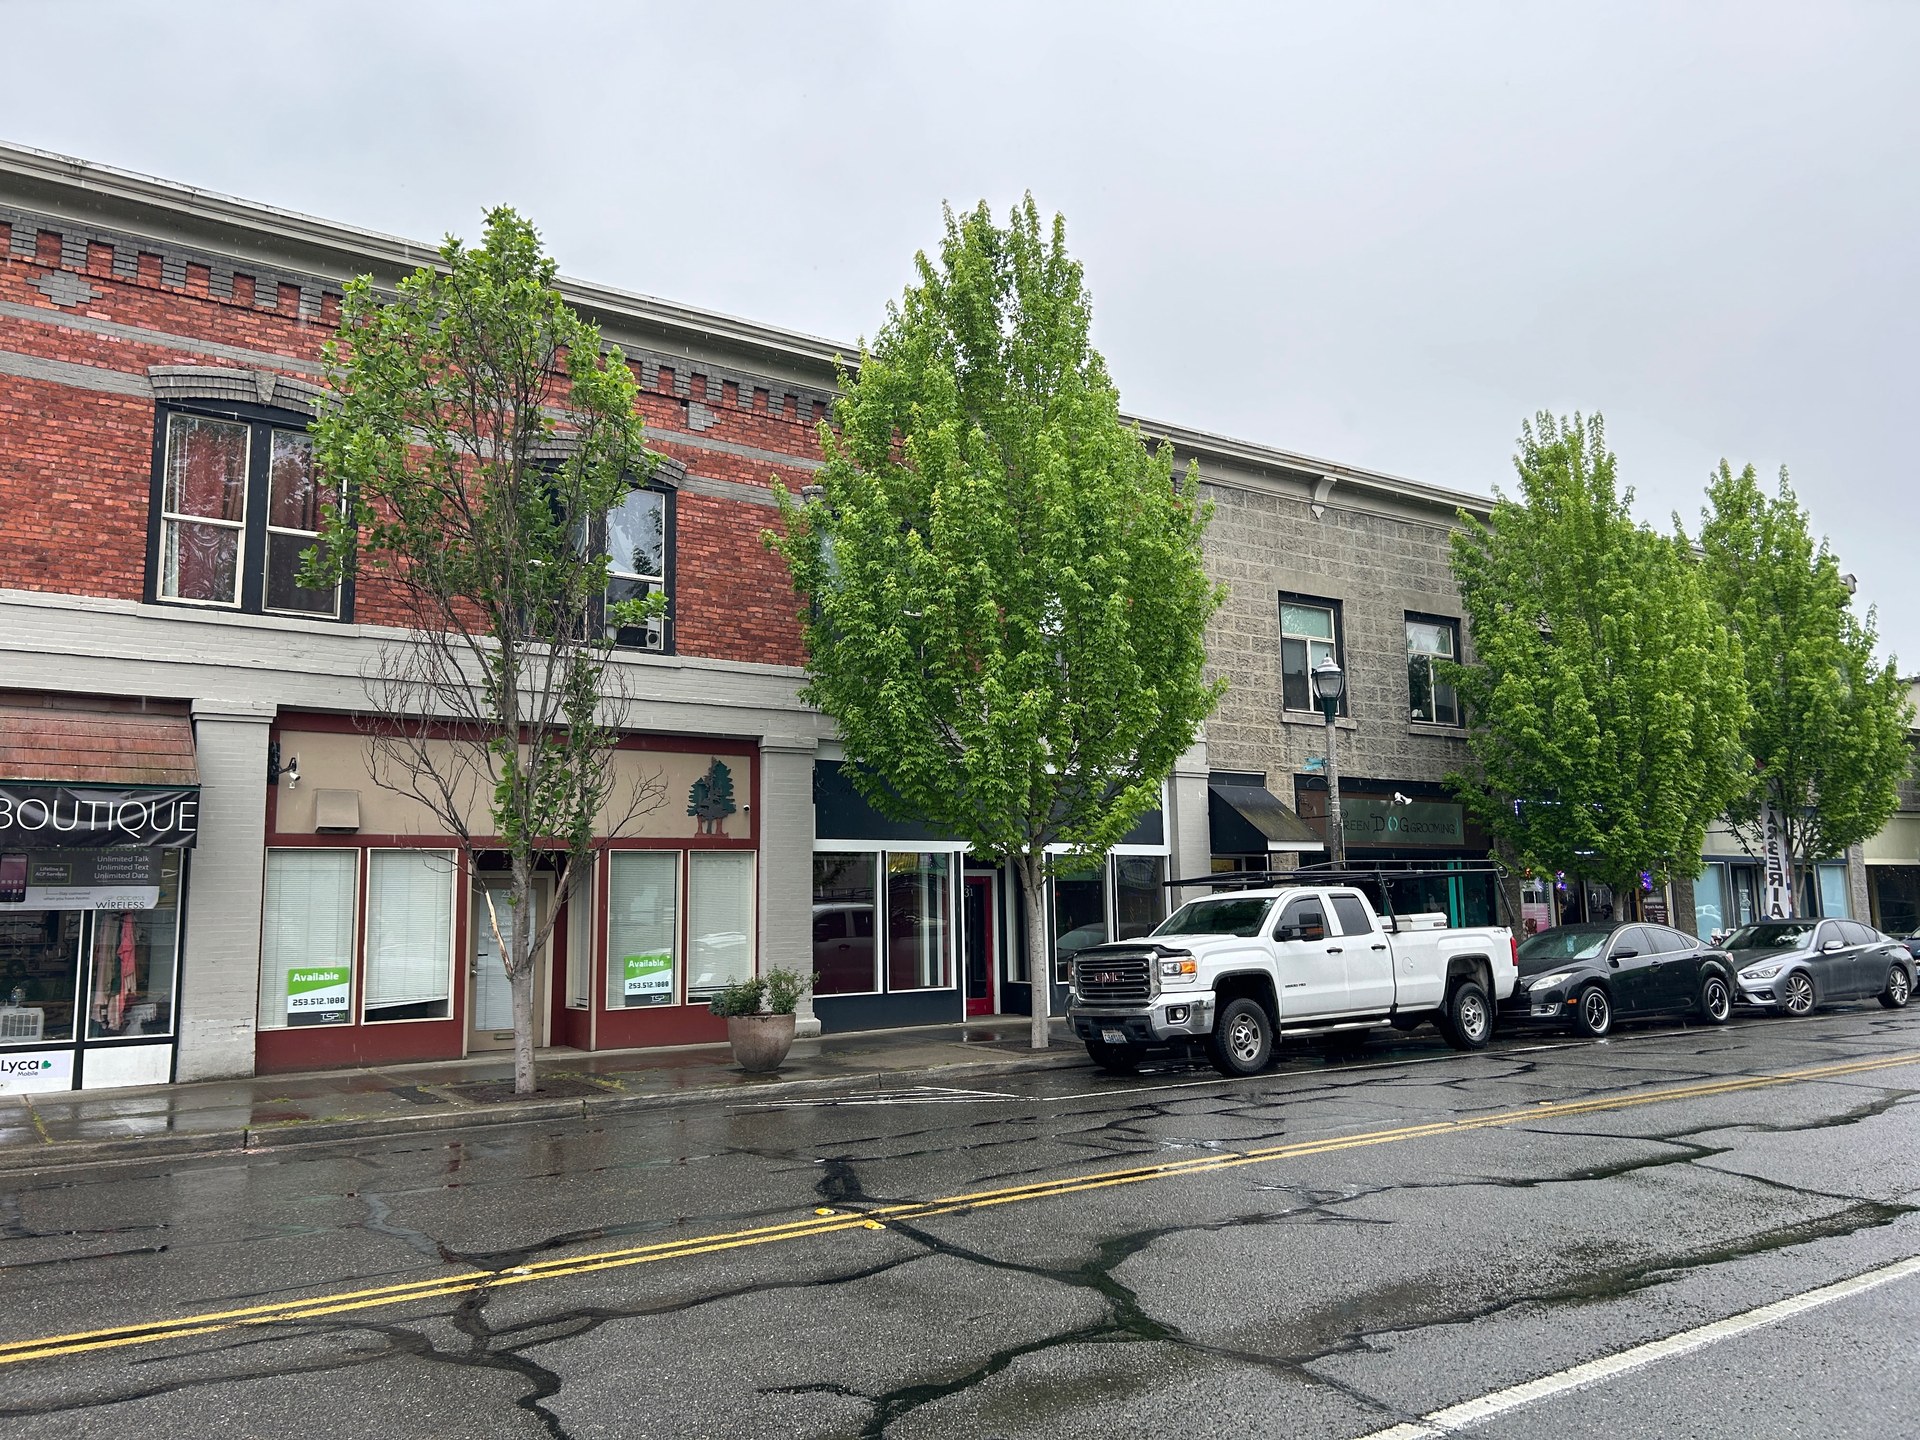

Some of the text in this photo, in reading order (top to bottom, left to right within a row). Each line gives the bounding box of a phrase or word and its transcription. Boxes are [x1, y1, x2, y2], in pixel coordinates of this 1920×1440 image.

[0, 798, 198, 839] BOUTIQUE
[1341, 809, 1370, 831] REEN
[1410, 822, 1456, 834] GROOMING
[628, 959, 665, 968] Available
[292, 971, 340, 982] Available
[1094, 972, 1125, 984] GMC
[1, 1060, 39, 1073] Lyca
